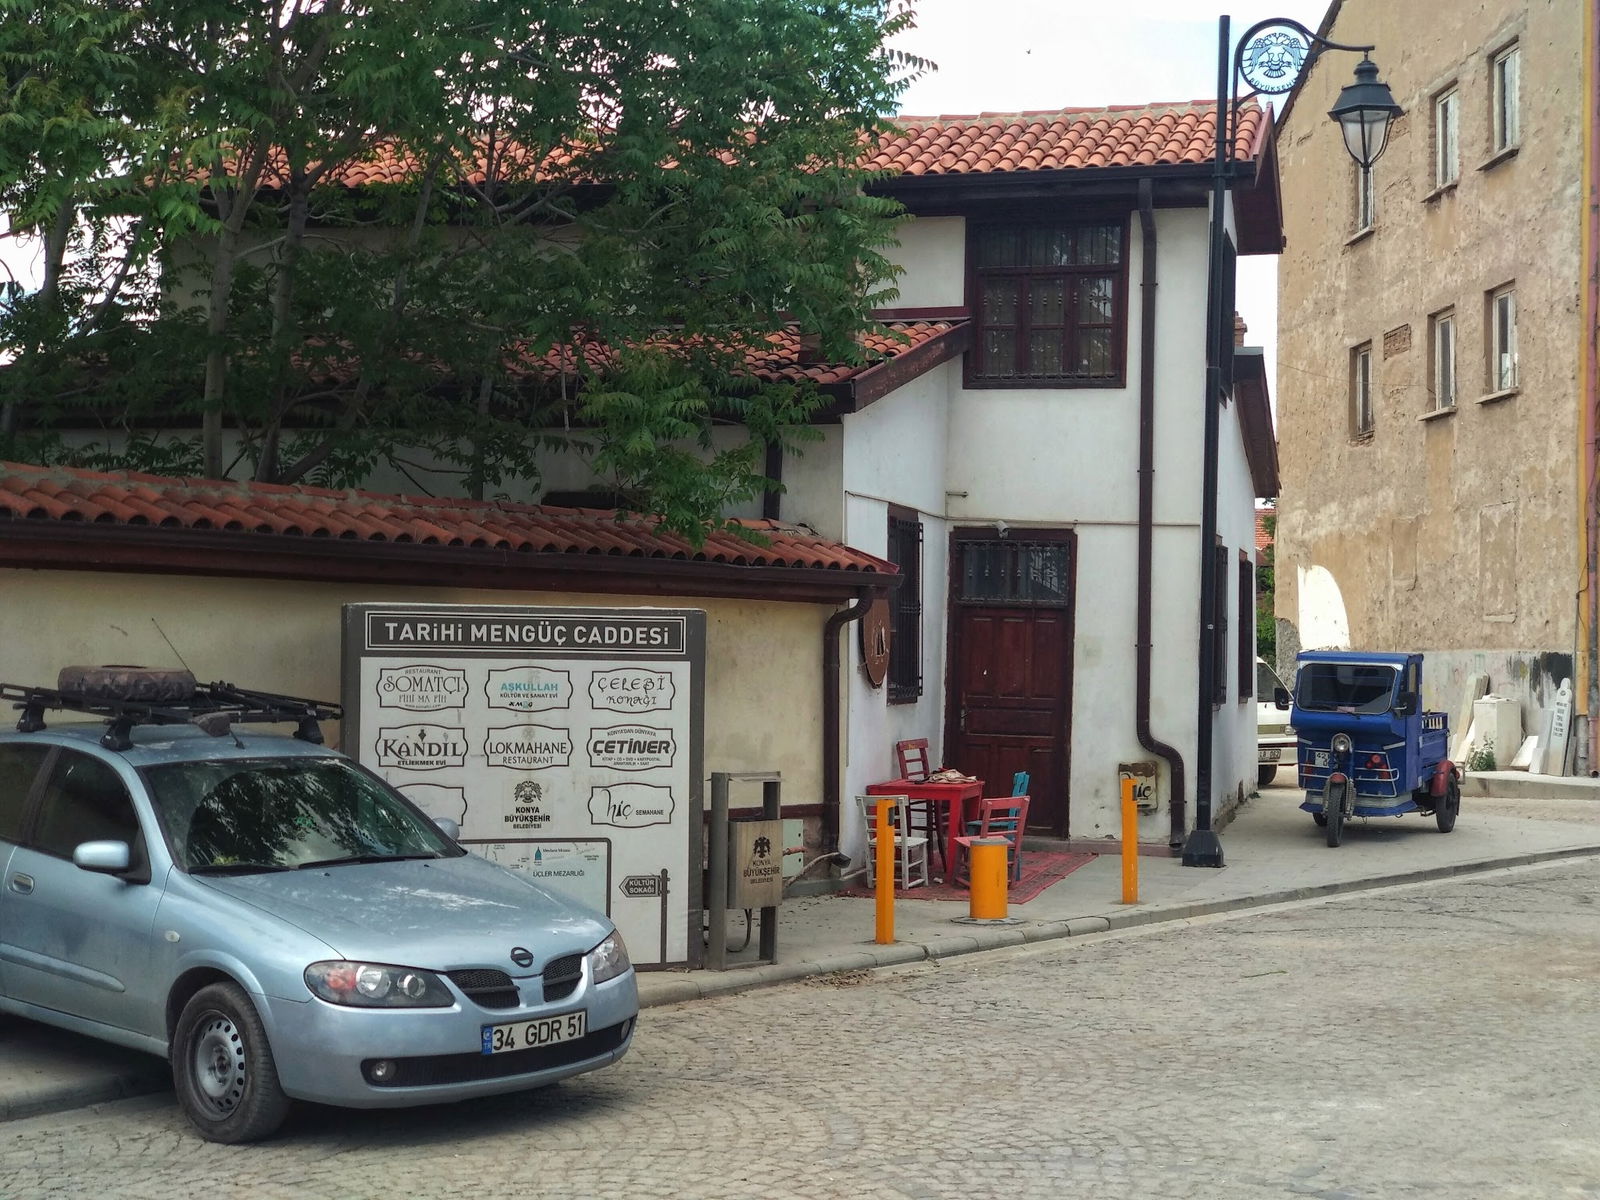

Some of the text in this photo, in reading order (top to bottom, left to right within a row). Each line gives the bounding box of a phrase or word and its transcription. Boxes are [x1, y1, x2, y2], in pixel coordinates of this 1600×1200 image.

[470, 621, 567, 646] MENGÜÇ
[501, 682, 559, 692] AŞKULLAH
[489, 742, 567, 754] LOKMAHANE
[502, 756, 554, 764] RESTAURANT
[515, 806, 540, 814] KONYA
[504, 813, 551, 823] BÜYÜKŞEHİR
[533, 870, 585, 878] ÜÇLER MEZARLIĞI
[743, 865, 780, 878] BÜYÜKŞEHİR
[630, 879, 655, 887] KÜLTÜR
[493, 1014, 582, 1051] 34 GDR 51
